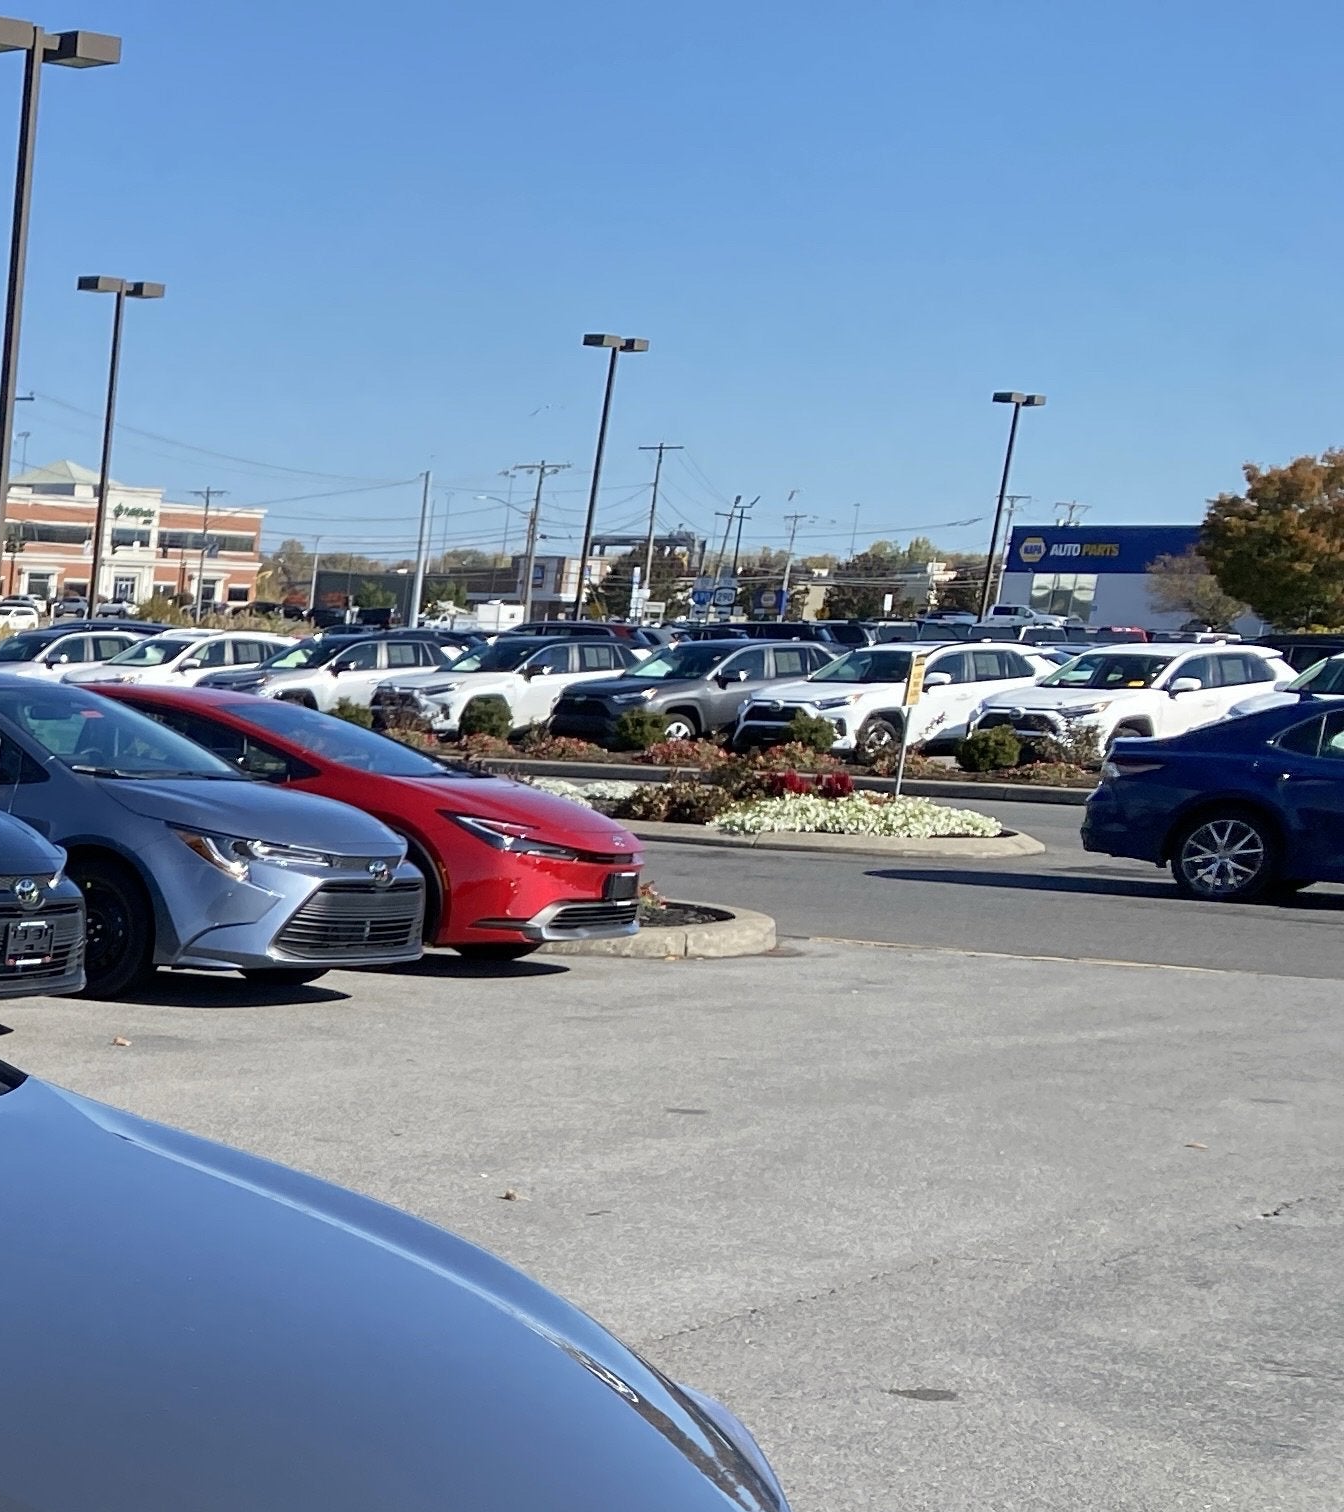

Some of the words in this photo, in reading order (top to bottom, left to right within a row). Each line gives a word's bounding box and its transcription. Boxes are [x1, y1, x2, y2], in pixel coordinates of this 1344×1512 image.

[1050, 543, 1081, 556] AUTO
[1081, 543, 1120, 556] PARTS
[716, 592, 733, 602] 290
